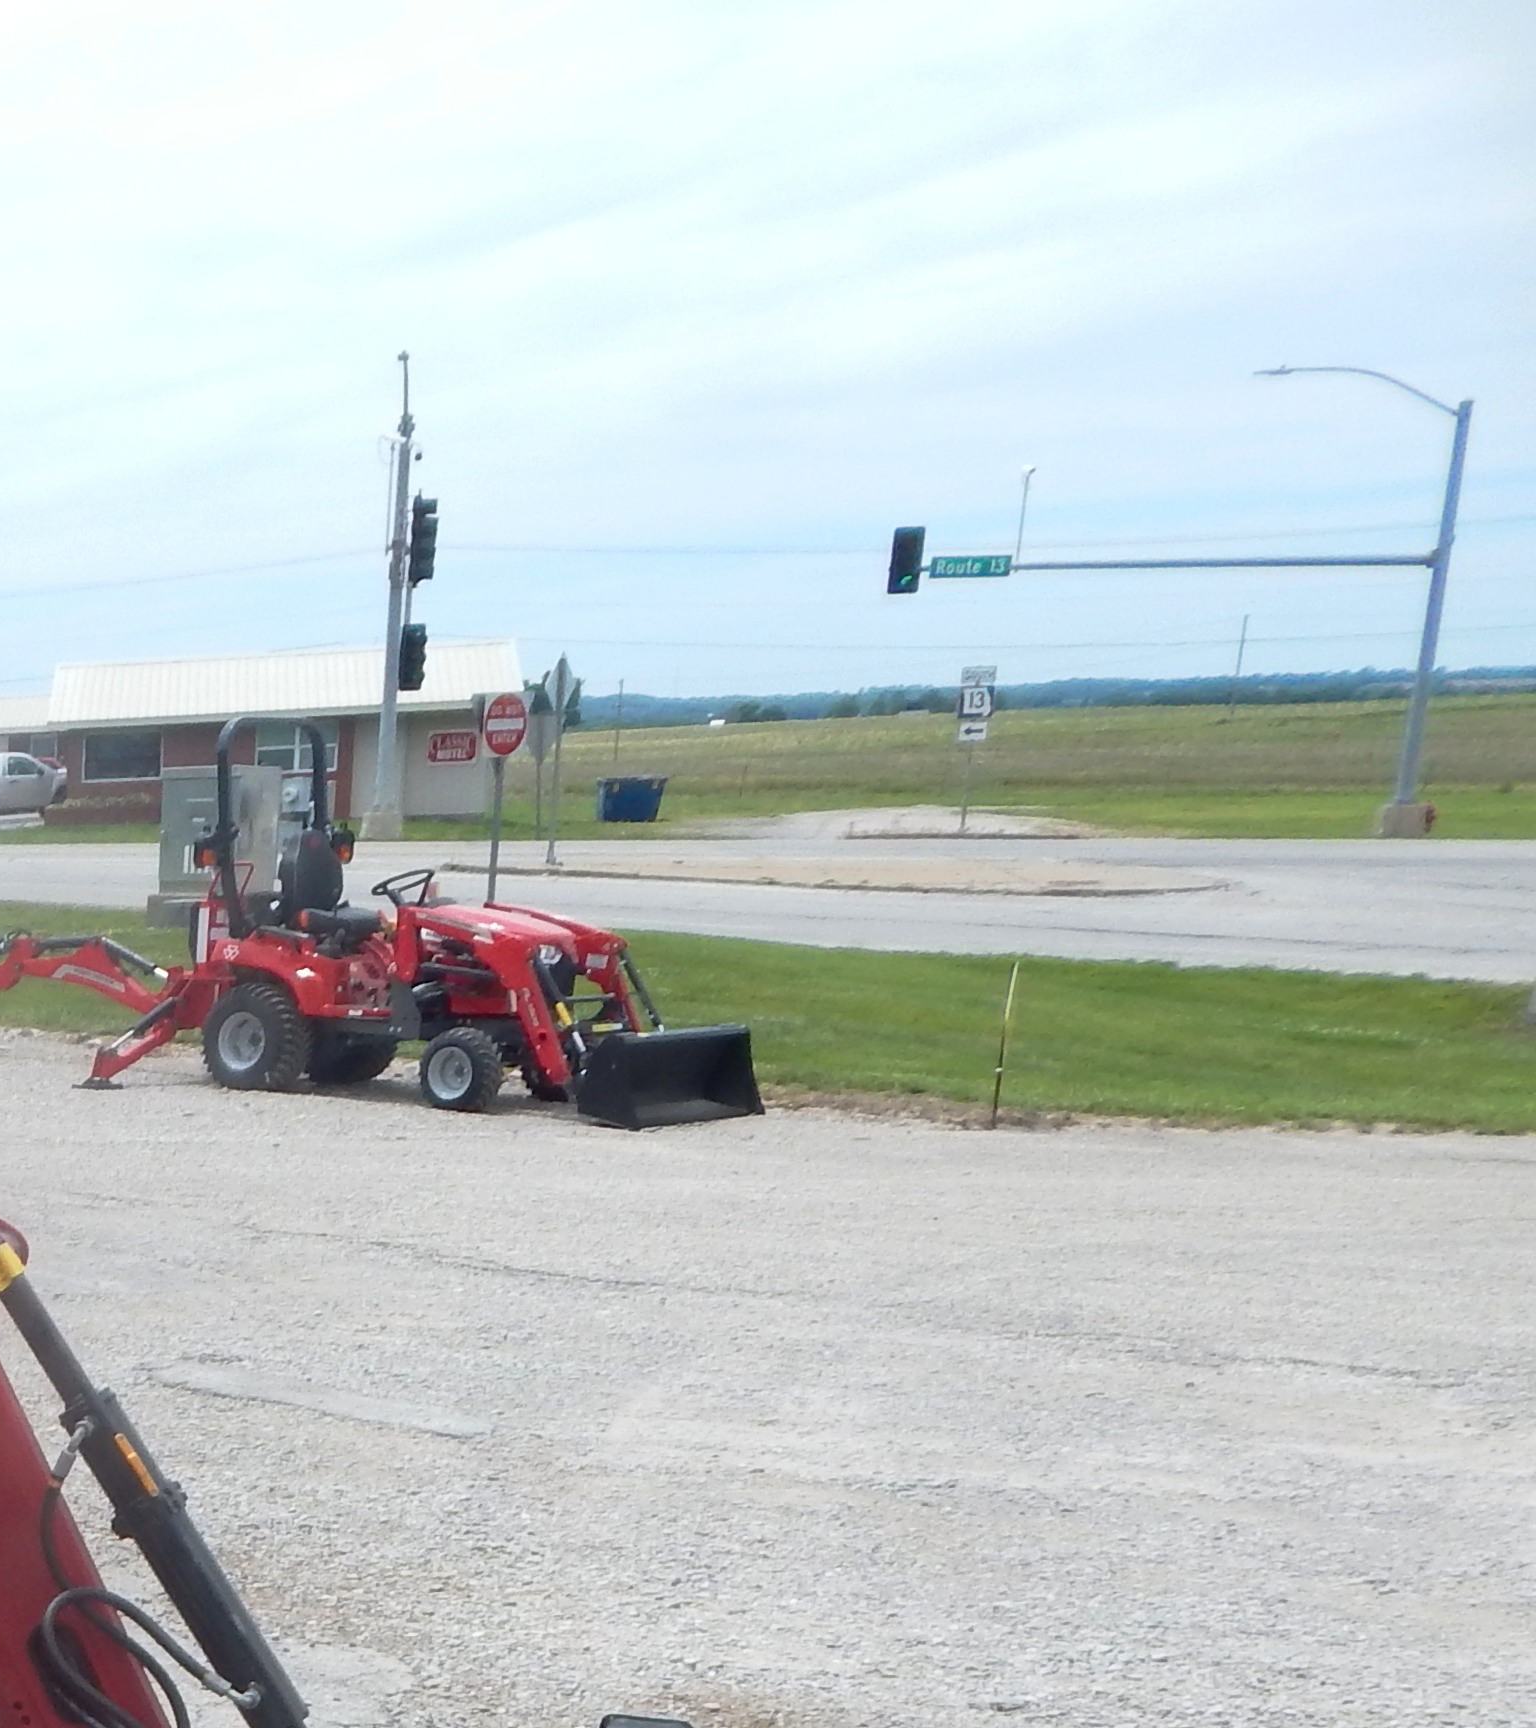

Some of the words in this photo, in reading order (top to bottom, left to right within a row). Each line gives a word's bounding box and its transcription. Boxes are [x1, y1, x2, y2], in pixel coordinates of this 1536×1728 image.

[935, 558, 982, 575] Route
[990, 558, 1008, 574] 13
[968, 691, 985, 709] 13
